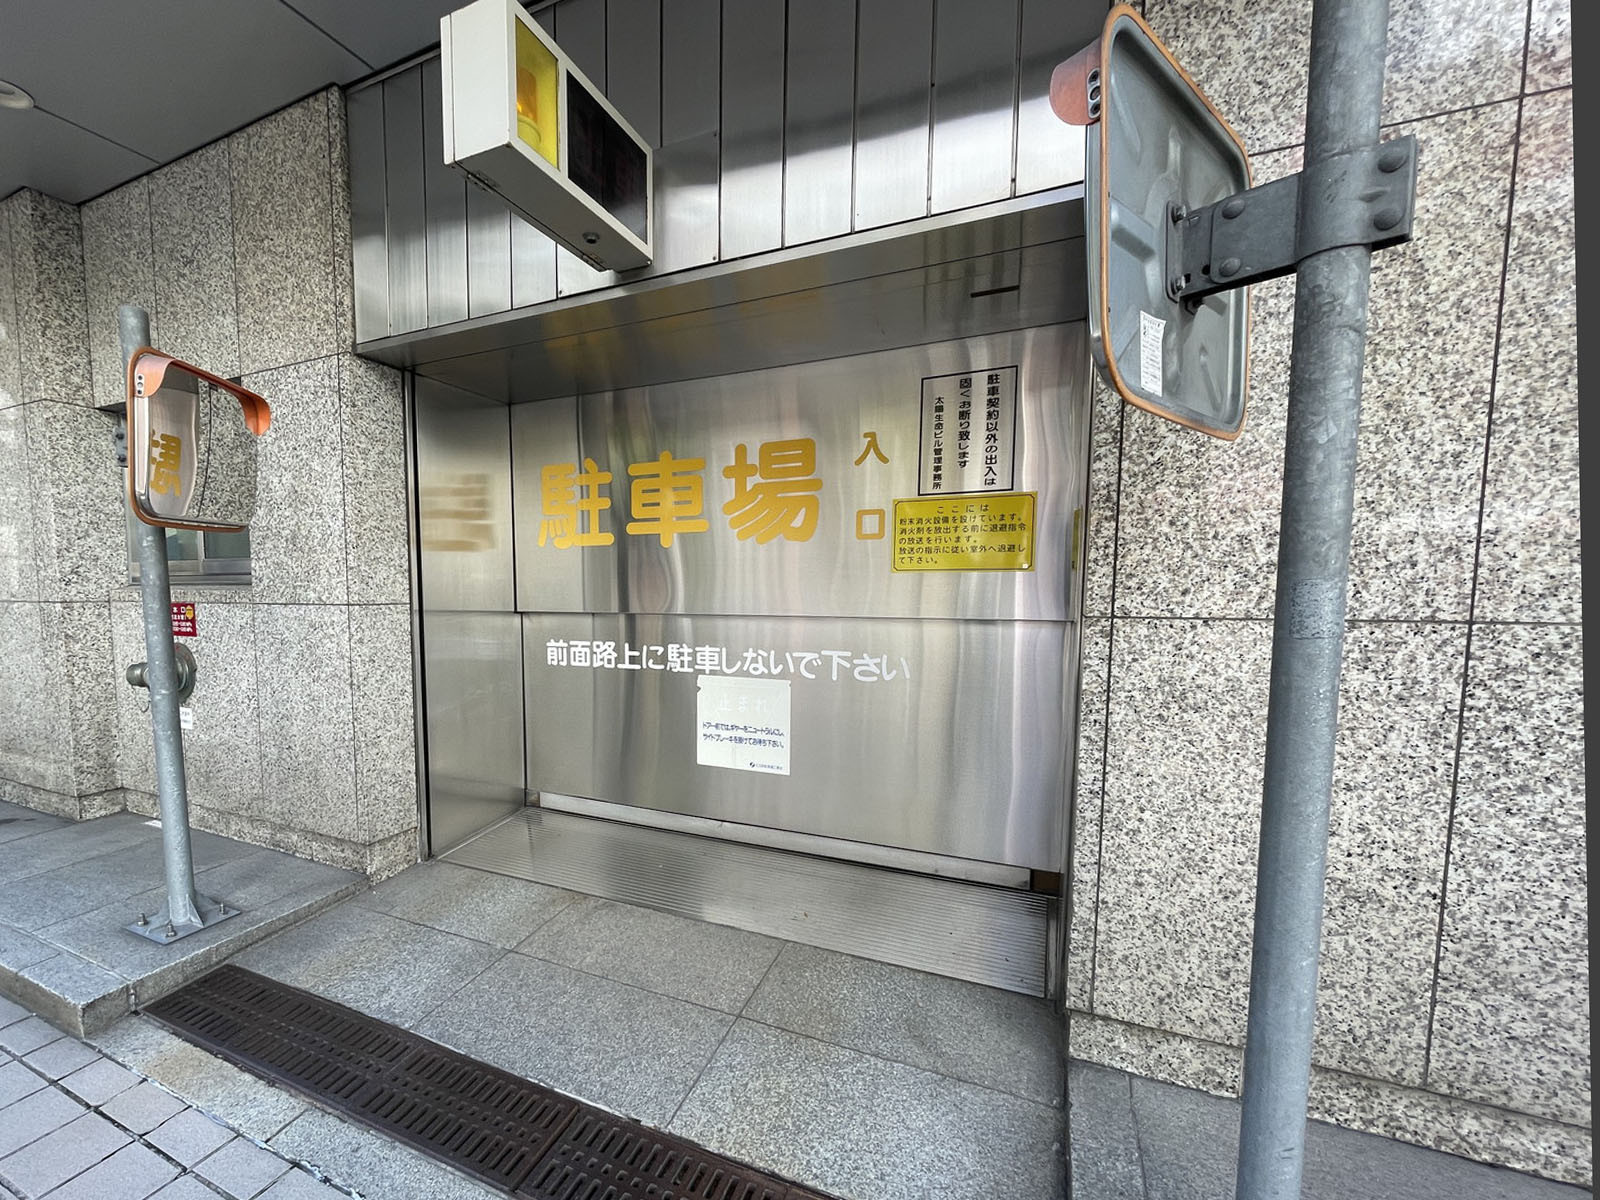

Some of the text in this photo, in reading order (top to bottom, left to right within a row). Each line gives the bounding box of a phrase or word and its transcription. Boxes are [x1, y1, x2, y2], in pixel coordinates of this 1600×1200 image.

[958, 378, 972, 469] 固くお断り致します
[984, 374, 1001, 486] 駐車契約以外の出入は
[537, 437, 823, 549] 駐車場
[937, 504, 990, 514] ここには
[899, 513, 1023, 525] 粉末消火設備を設けています。
[899, 523, 1027, 535] 消火剤を放出する前に退避指令
[899, 536, 978, 545] の放送を行います。
[899, 544, 1025, 555] 放送の指示に従い室外へ退避し
[899, 556, 938, 565] て下さい。
[546, 638, 911, 682] 前面路上に駐車しないで下さい
